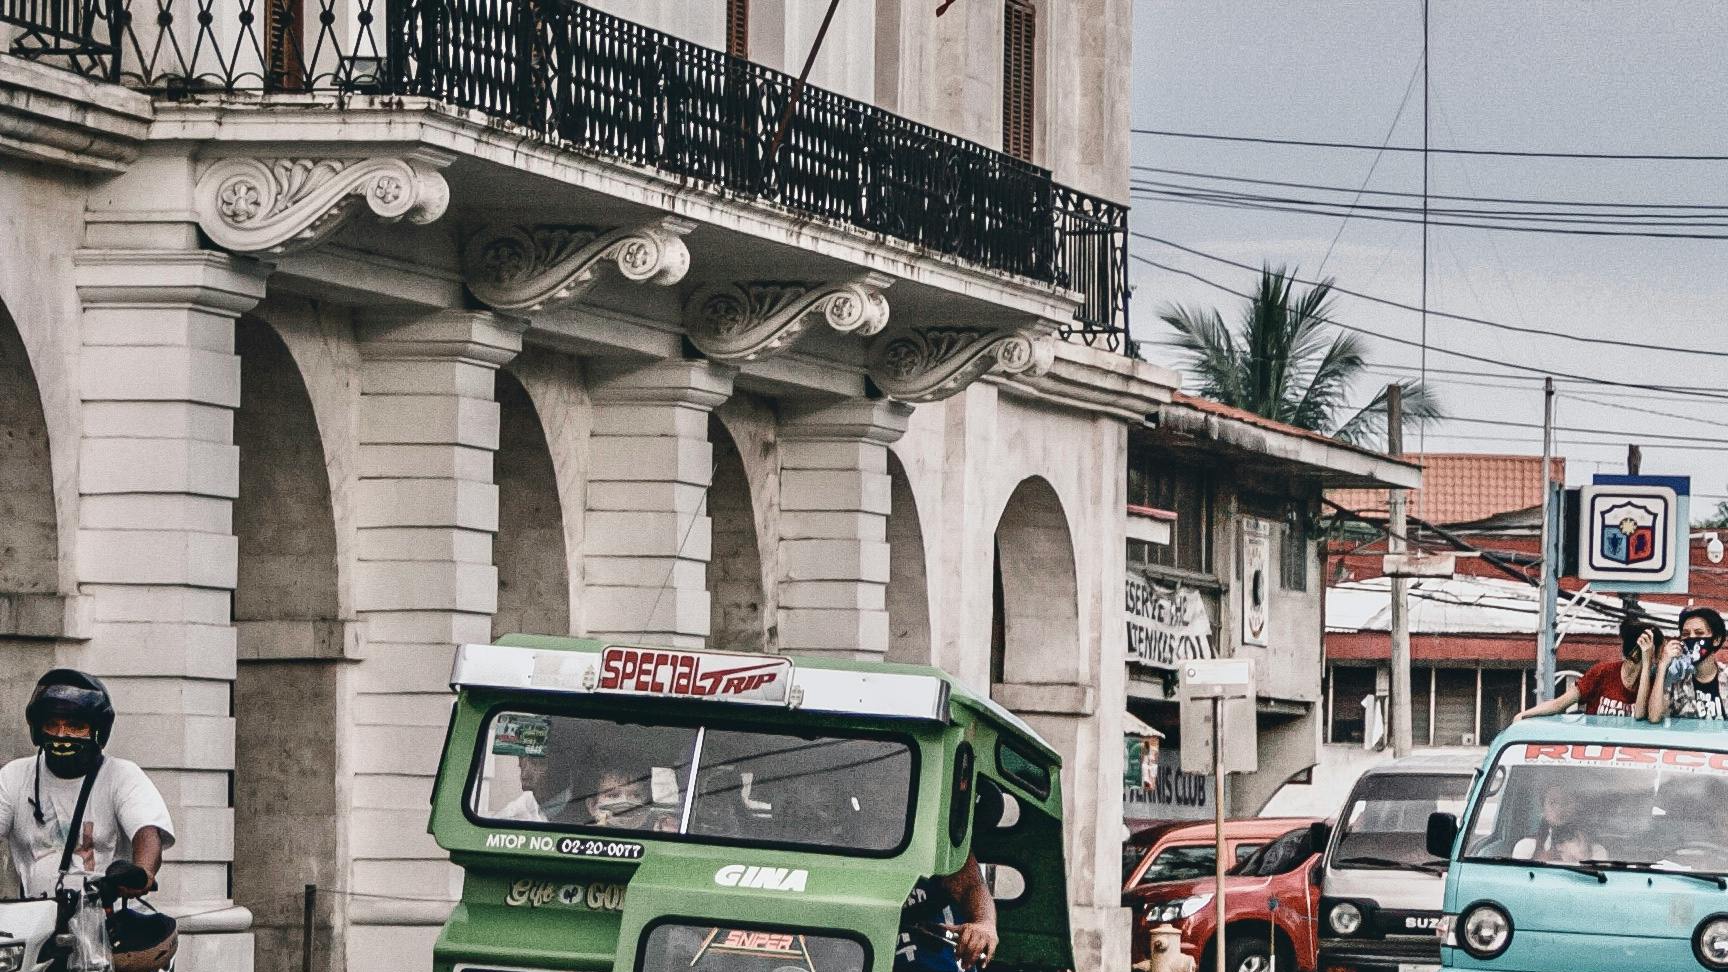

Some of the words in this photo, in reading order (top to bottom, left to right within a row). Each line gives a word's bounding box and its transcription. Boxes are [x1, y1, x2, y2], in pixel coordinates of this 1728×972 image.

[700, 662, 785, 695] TRIP
[486, 833, 526, 849] MTOP
[714, 864, 809, 892] GINA
